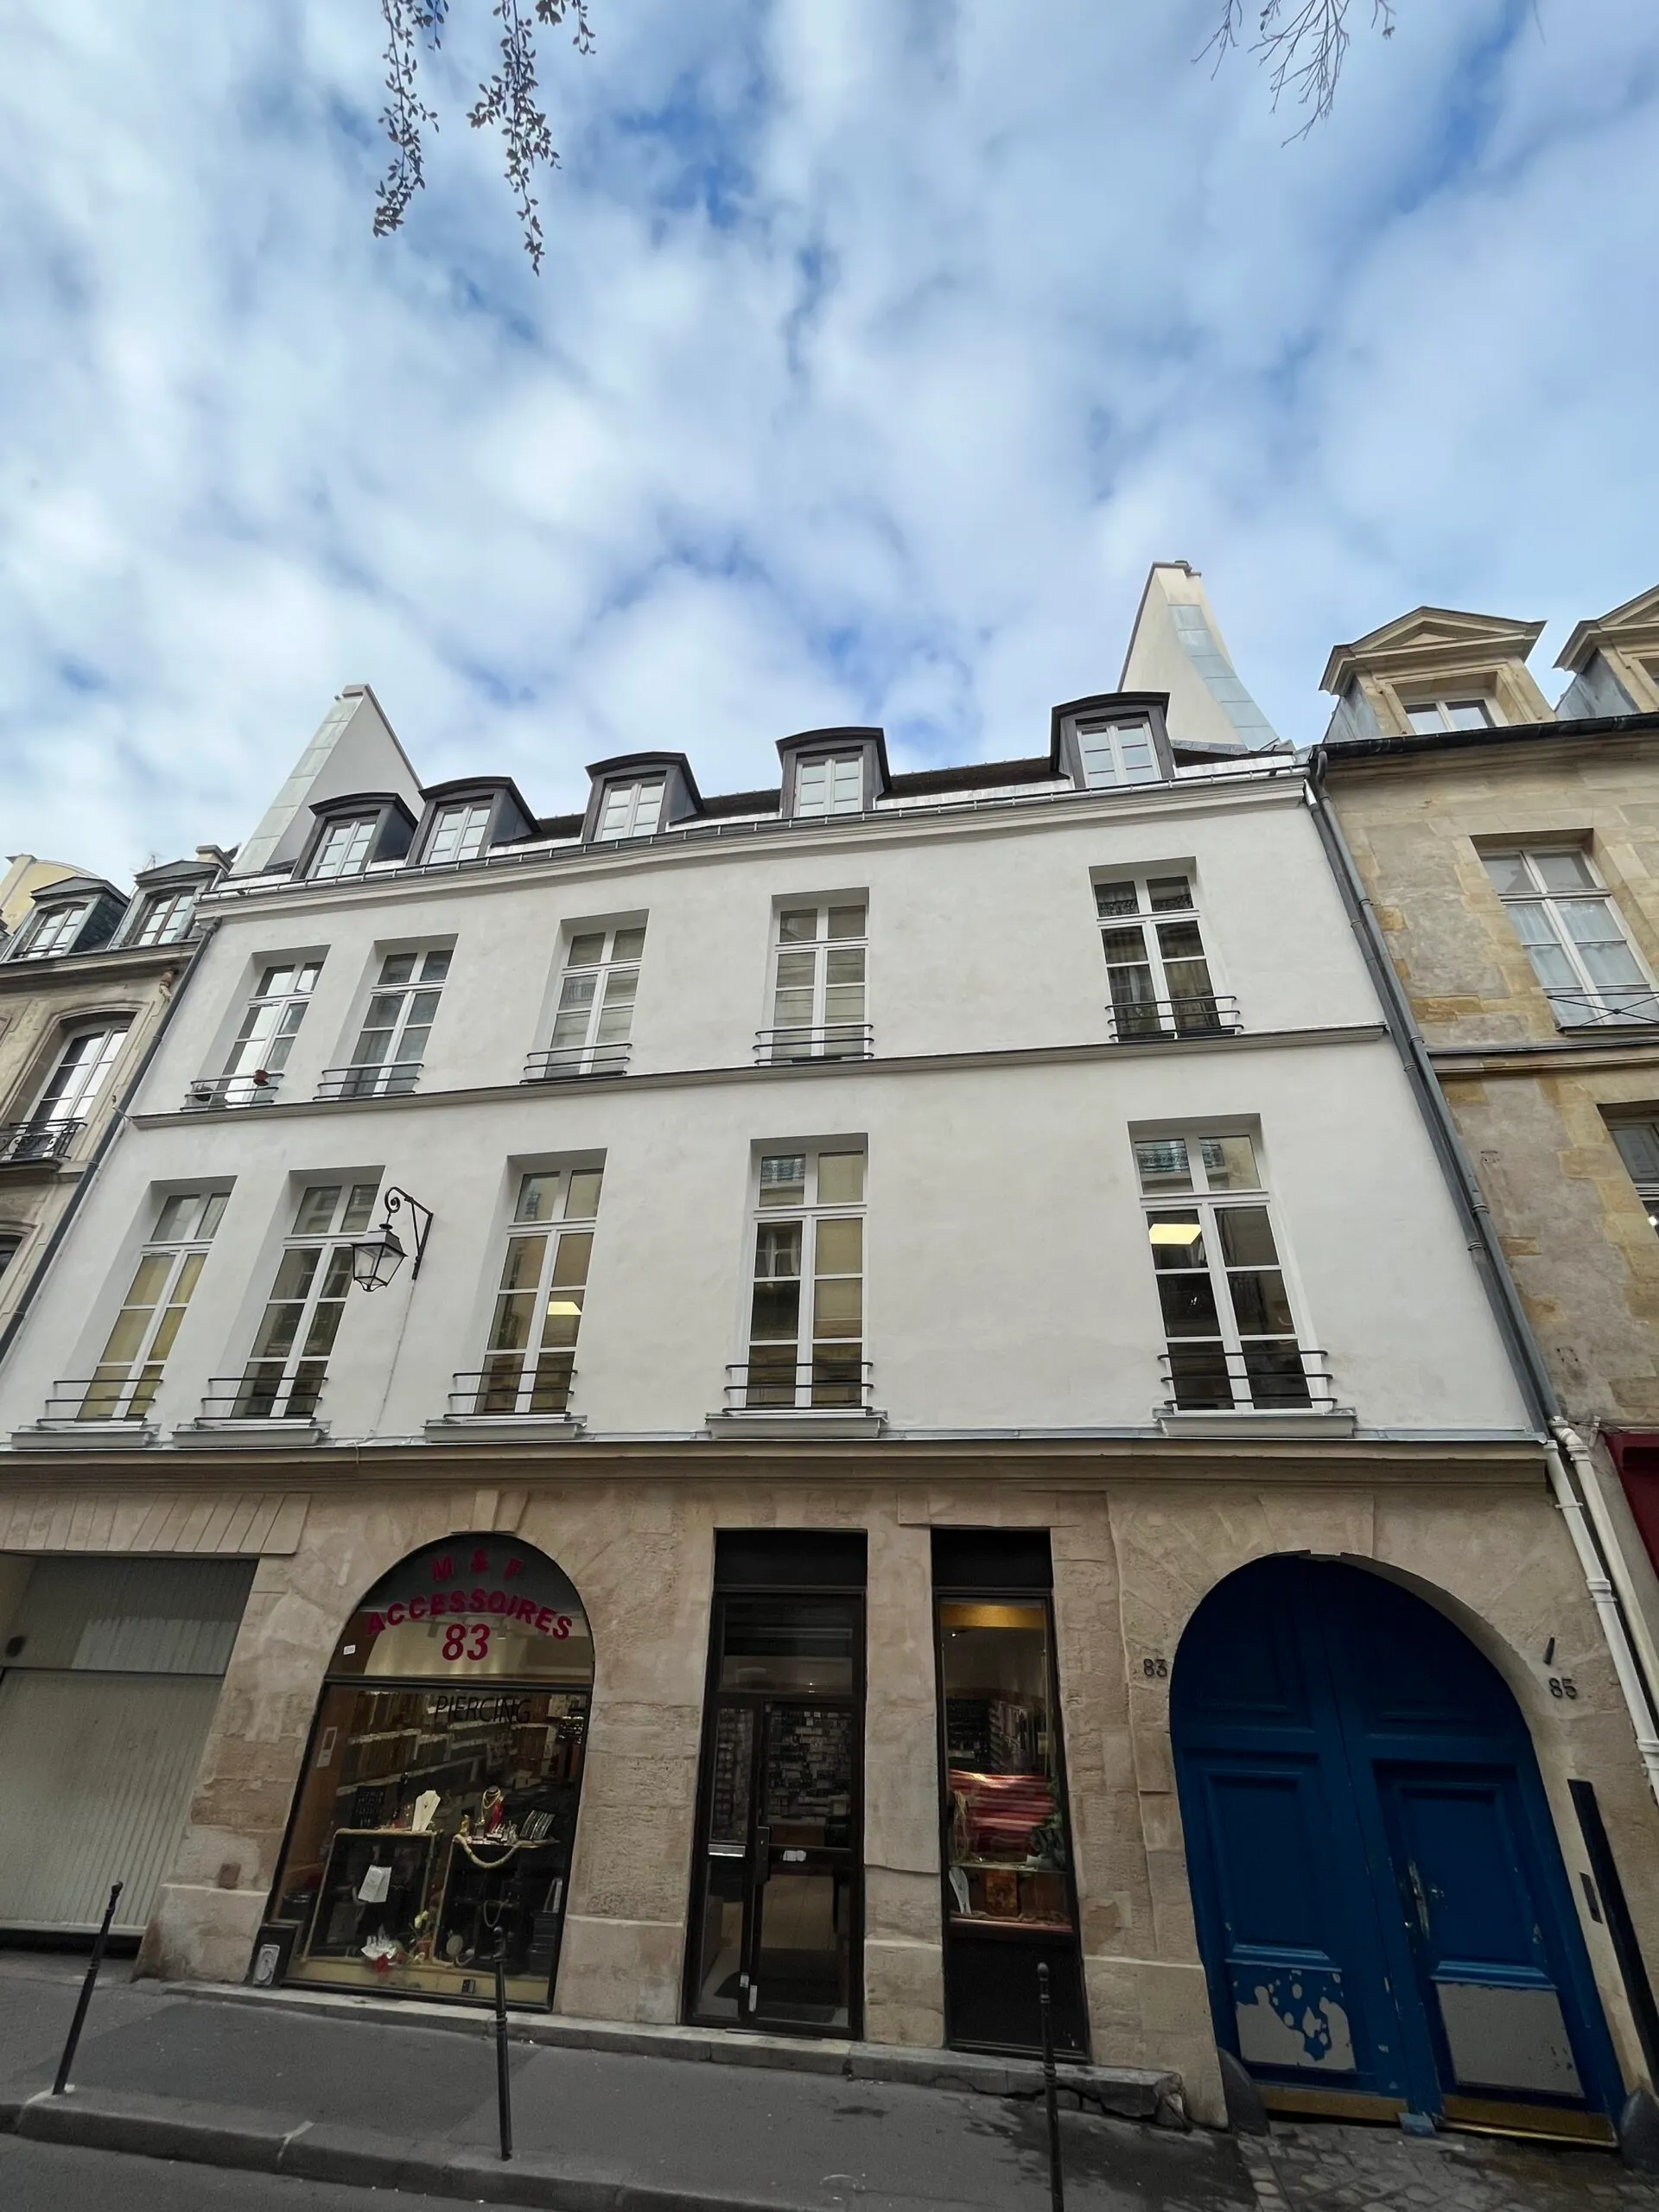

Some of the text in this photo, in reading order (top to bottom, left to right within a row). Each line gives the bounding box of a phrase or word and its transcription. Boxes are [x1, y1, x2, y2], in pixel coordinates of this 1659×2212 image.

[431, 1552, 454, 1581] M
[470, 1548, 489, 1573] &
[366, 1588, 573, 1641] ACCESSOIRES
[442, 1624, 491, 1661] 83
[1143, 1658, 1167, 1677] 83
[1548, 1677, 1578, 1700] 85
[434, 1695, 531, 1724] PIERCING
